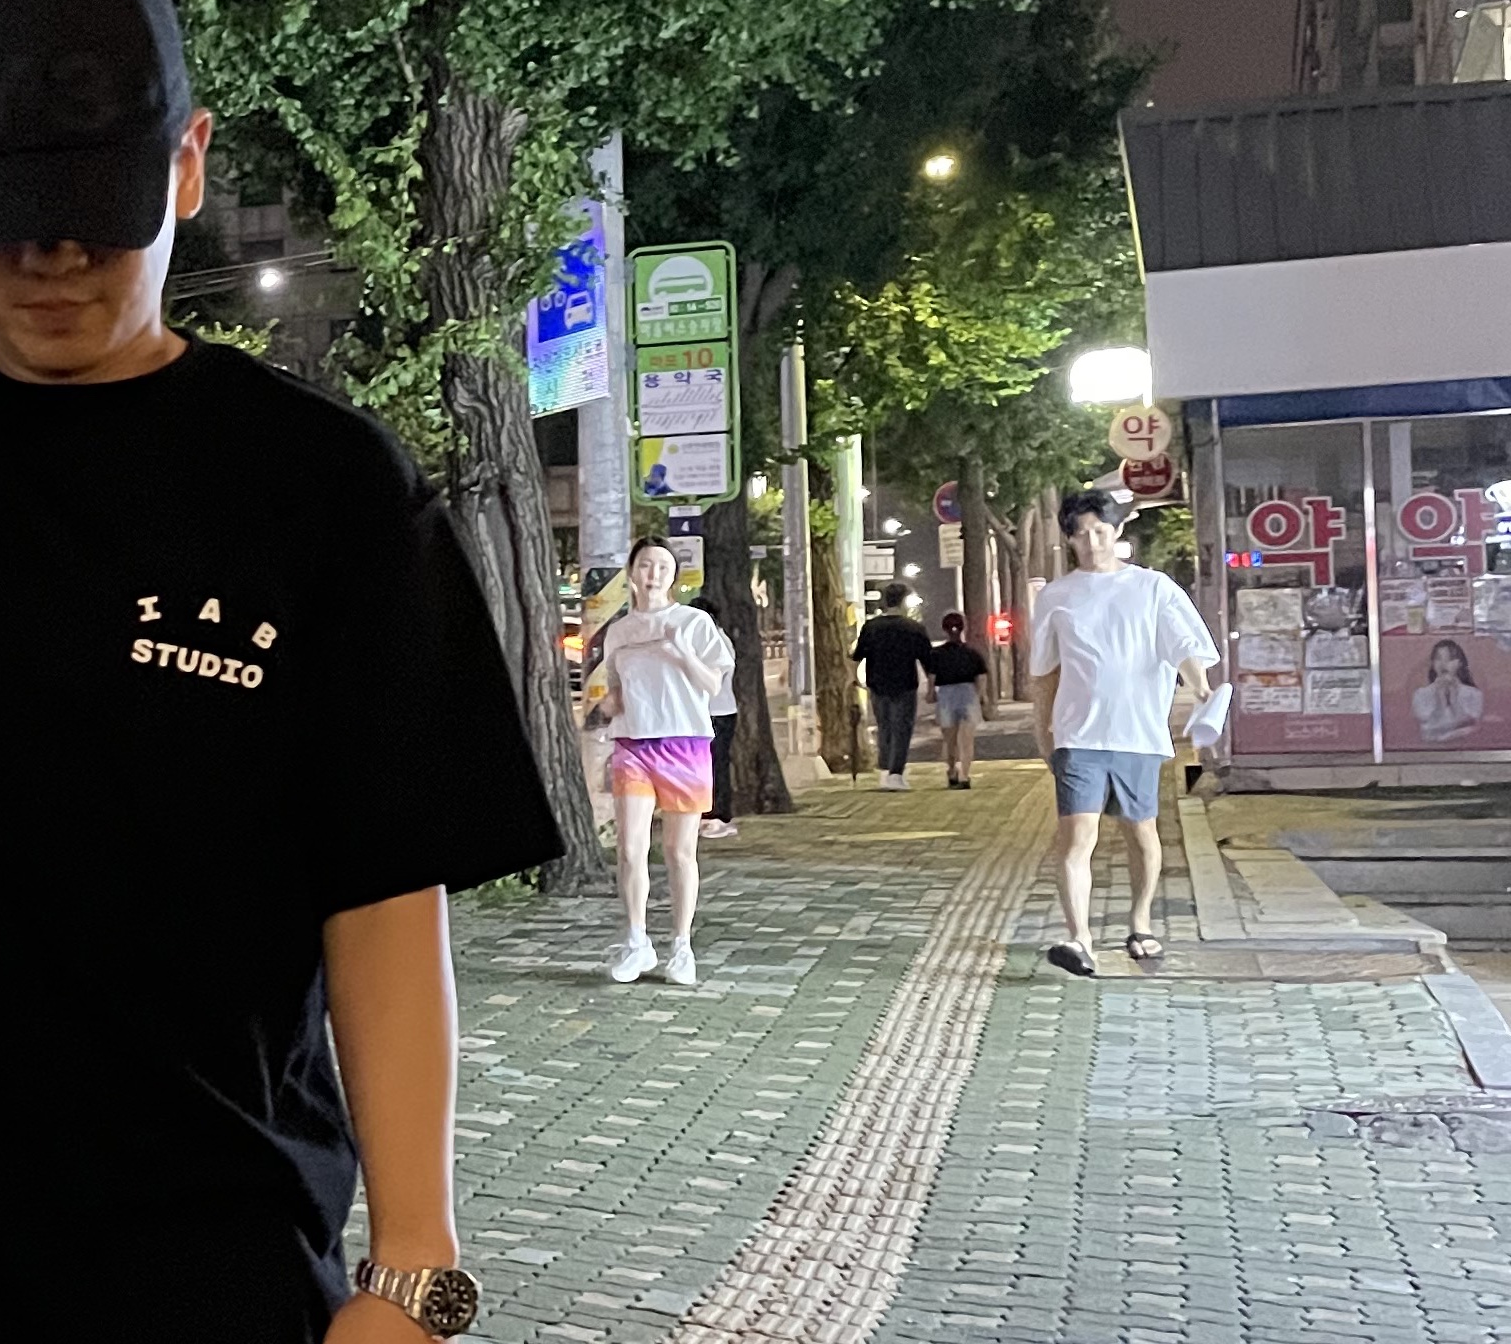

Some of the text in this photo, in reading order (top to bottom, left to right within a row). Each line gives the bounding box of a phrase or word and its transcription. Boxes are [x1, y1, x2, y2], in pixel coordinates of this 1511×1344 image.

[682, 347, 713, 368] 10
[1122, 414, 1160, 451] 약
[1247, 495, 1346, 587] 약
[1397, 488, 1495, 576] 약
[131, 638, 263, 688] STUDIO
